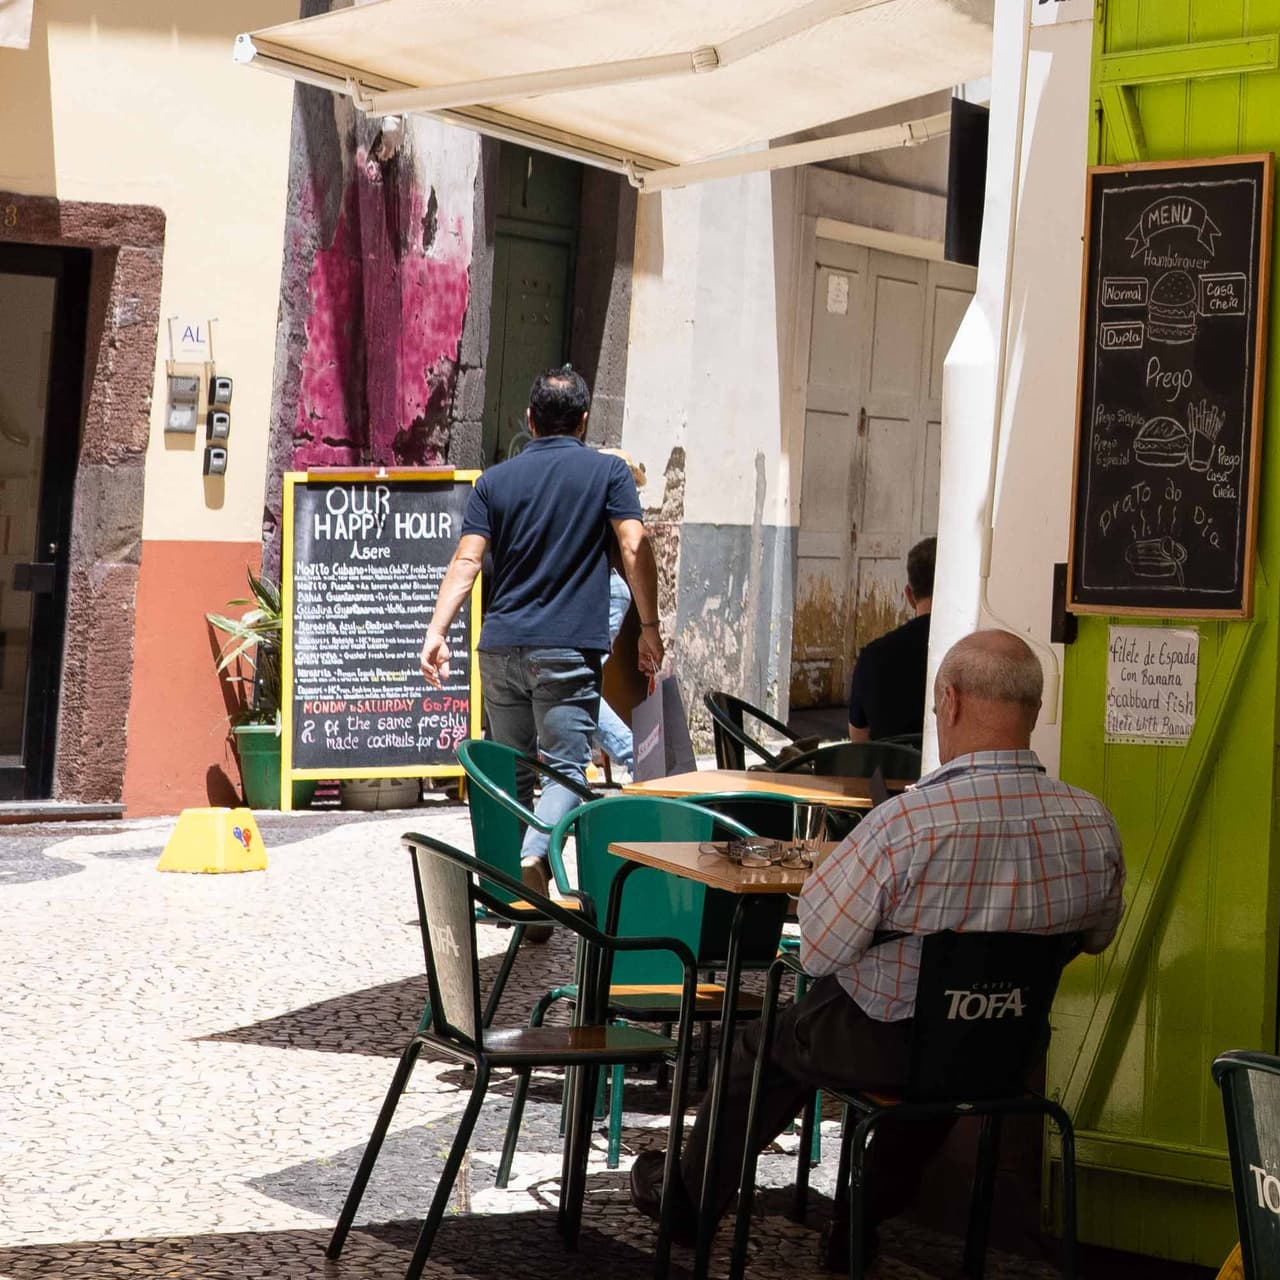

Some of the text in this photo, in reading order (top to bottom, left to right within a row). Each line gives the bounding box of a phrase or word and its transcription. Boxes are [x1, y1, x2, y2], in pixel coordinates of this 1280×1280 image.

[1148, 203, 1192, 228] MENU
[1106, 285, 1142, 301] Normal
[1206, 283, 1234, 297] Casa
[182, 326, 206, 343] AL
[1107, 330, 1141, 346] Dupla
[1145, 356, 1193, 402] Prego
[326, 485, 390, 515] OUR
[314, 513, 452, 540] HAPPY HOUR
[1144, 641, 1155, 666] de
[1159, 642, 1196, 672] Espada
[1141, 668, 1183, 686] Banana
[303, 699, 346, 714] MONDAY
[357, 699, 415, 713] SATURDAY
[1108, 687, 1160, 709] Scabbard
[347, 716, 370, 730] the
[377, 717, 412, 730] same
[417, 712, 467, 735] freshly
[326, 737, 359, 750] made
[416, 737, 433, 752] for
[944, 988, 1027, 1020] TOFA
